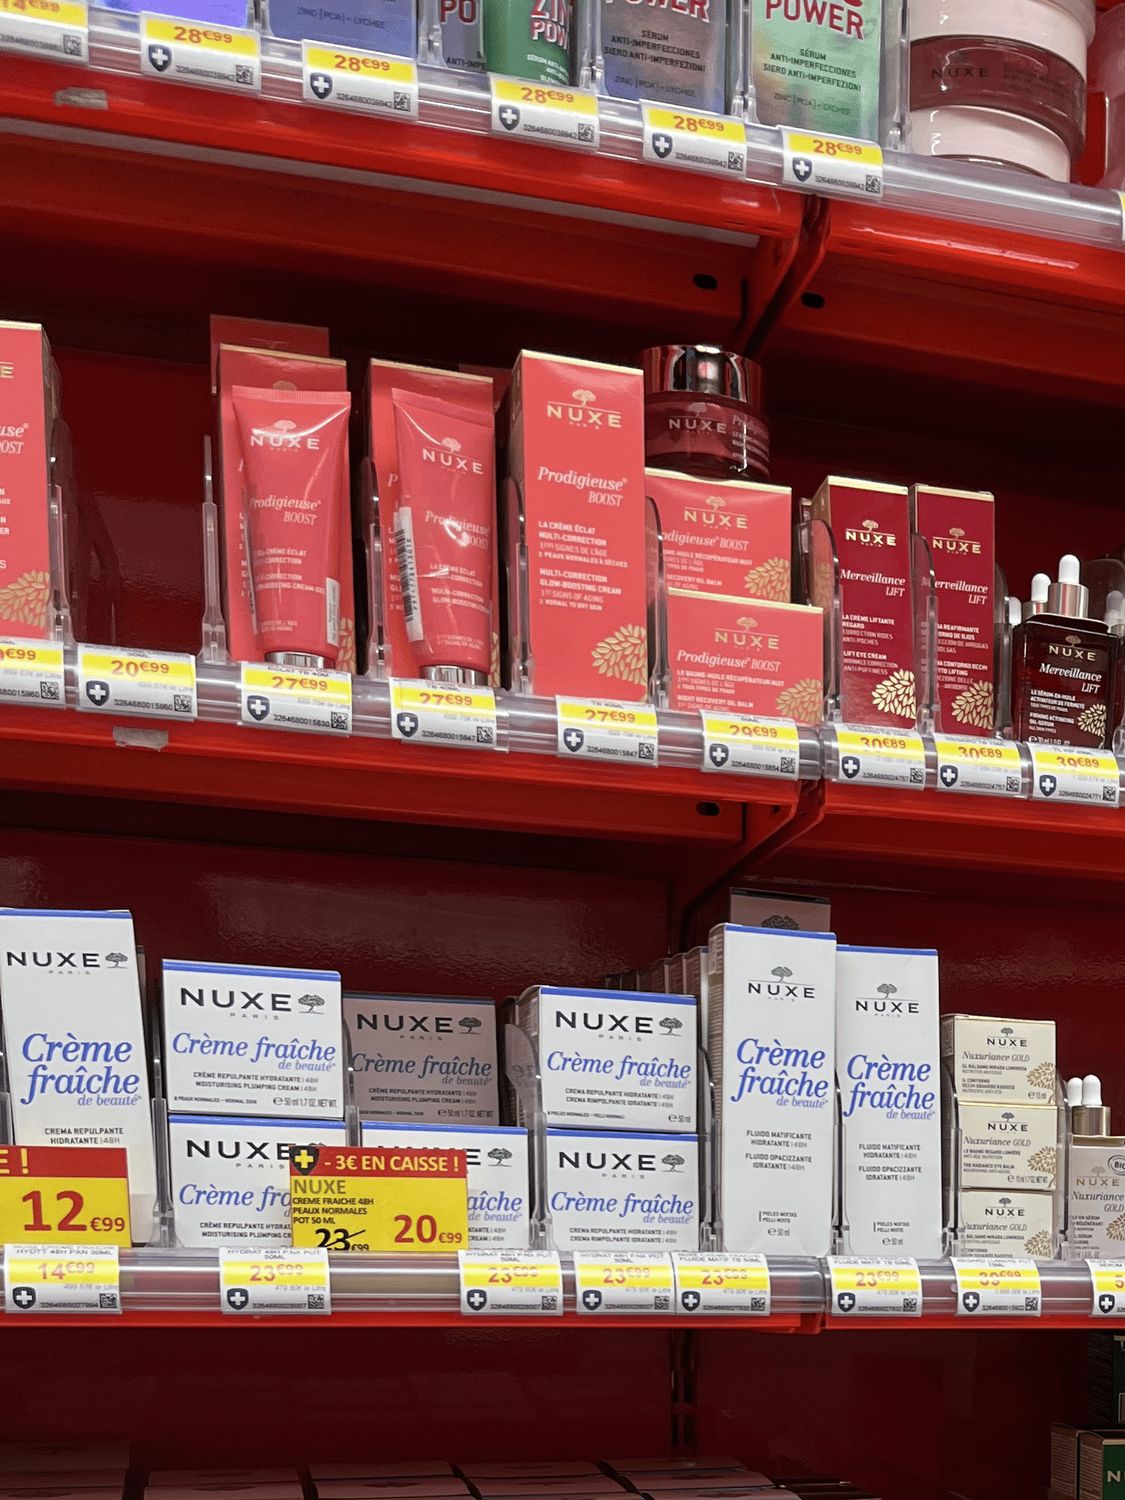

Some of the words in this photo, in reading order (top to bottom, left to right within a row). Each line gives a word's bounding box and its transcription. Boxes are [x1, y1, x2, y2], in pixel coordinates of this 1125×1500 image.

[764, 0, 864, 41] POWER
[173, 25, 233, 46] 28€99
[800, 48, 826, 60] SÉRUM
[769, 52, 856, 78] ANTI-IMPERFECCIONES
[520, 87, 574, 104] 28€99
[812, 139, 863, 156] 28€99
[547, 404, 621, 428] NUXE
[588, 492, 623, 506] BOOST
[539, 532, 607, 546] MULTI-CORRECTION
[840, 568, 905, 587] Merveillance
[886, 585, 905, 597] LIFT
[714, 631, 780, 650] NUXE
[111, 659, 170, 677] 20€99
[6, 951, 100, 968] NUXE
[180, 988, 292, 1011] NUXE
[555, 1011, 653, 1033] NUXE
[22, 1033, 132, 1063] Crème
[172, 1032, 248, 1057] Crème
[250, 1037, 336, 1062] fraîche
[987, 1038, 1027, 1047] NUXE
[962, 1052, 1010, 1062] Nuxuriance
[1012, 1053, 1030, 1062] GOLD
[21, 1064, 139, 1105] fraîche
[746, 1130, 769, 1139] FLUIDO
[772, 1131, 812, 1140] MATIFICANTE
[336, 1156, 357, 1170] 3€
[362, 1156, 386, 1170] EN
[390, 1156, 447, 1171] CAISSE
[293, 1179, 346, 1195] NUXE
[293, 1197, 320, 1205] CREME
[321, 1197, 355, 1205] FRAICHE
[21, 1190, 125, 1232] 12€99
[293, 1207, 317, 1215] PEAUX
[320, 1207, 367, 1215] NORMALES
[394, 1215, 462, 1244] 20€99
